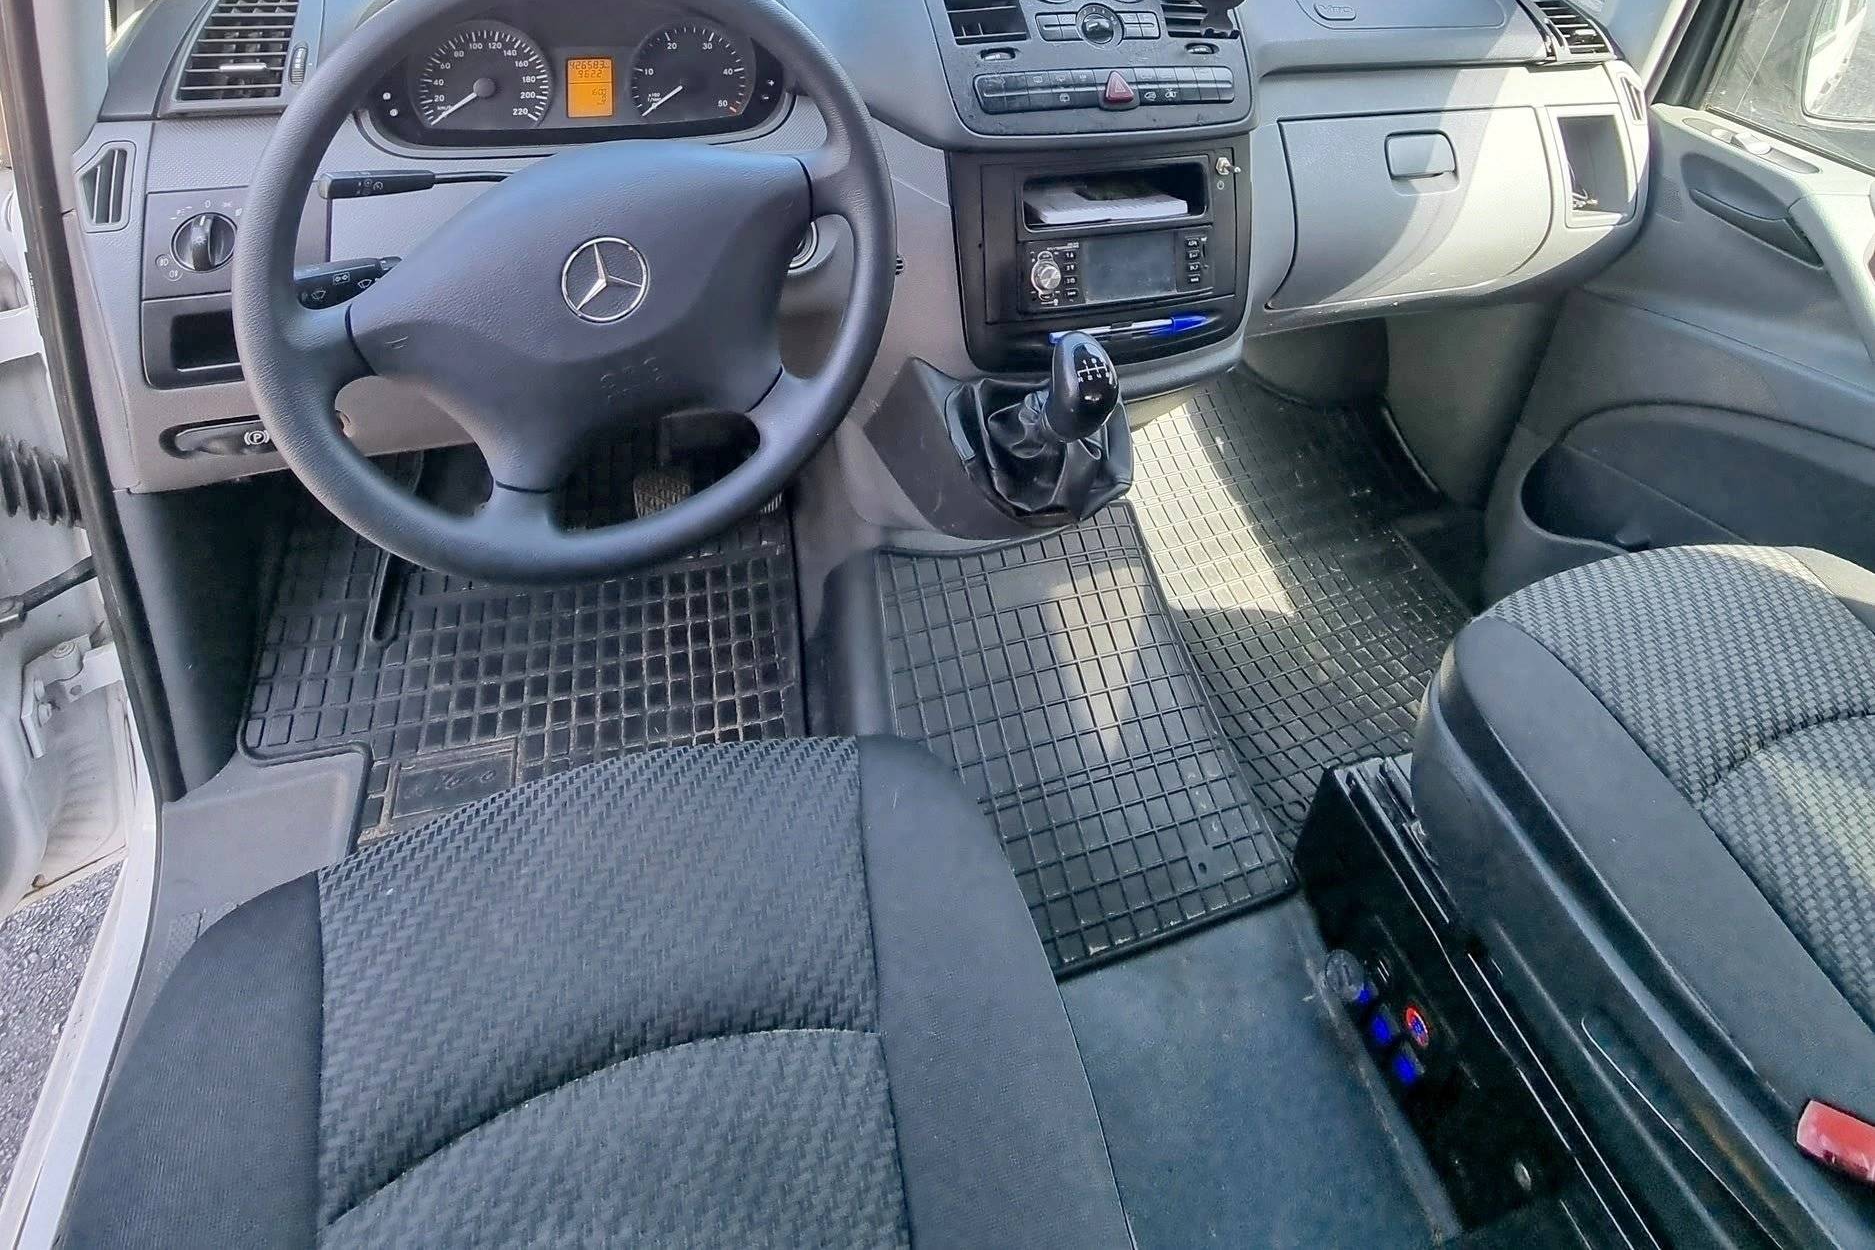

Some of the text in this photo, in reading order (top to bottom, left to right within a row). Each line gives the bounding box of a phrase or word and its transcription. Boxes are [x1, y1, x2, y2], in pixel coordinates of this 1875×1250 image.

[469, 42, 483, 50] 100
[488, 42, 502, 50] 120
[666, 42, 678, 50] 20
[702, 42, 713, 50] 30
[503, 49, 517, 57] 140
[440, 62, 451, 70] 60
[514, 60, 529, 68] 160
[644, 68, 655, 76] 10
[723, 68, 734, 76] 40
[433, 78, 445, 86] 40
[522, 75, 536, 83] 180
[434, 94, 445, 102] 20
[520, 91, 536, 100] 200
[718, 99, 728, 107] 50
[512, 107, 529, 116] 220
